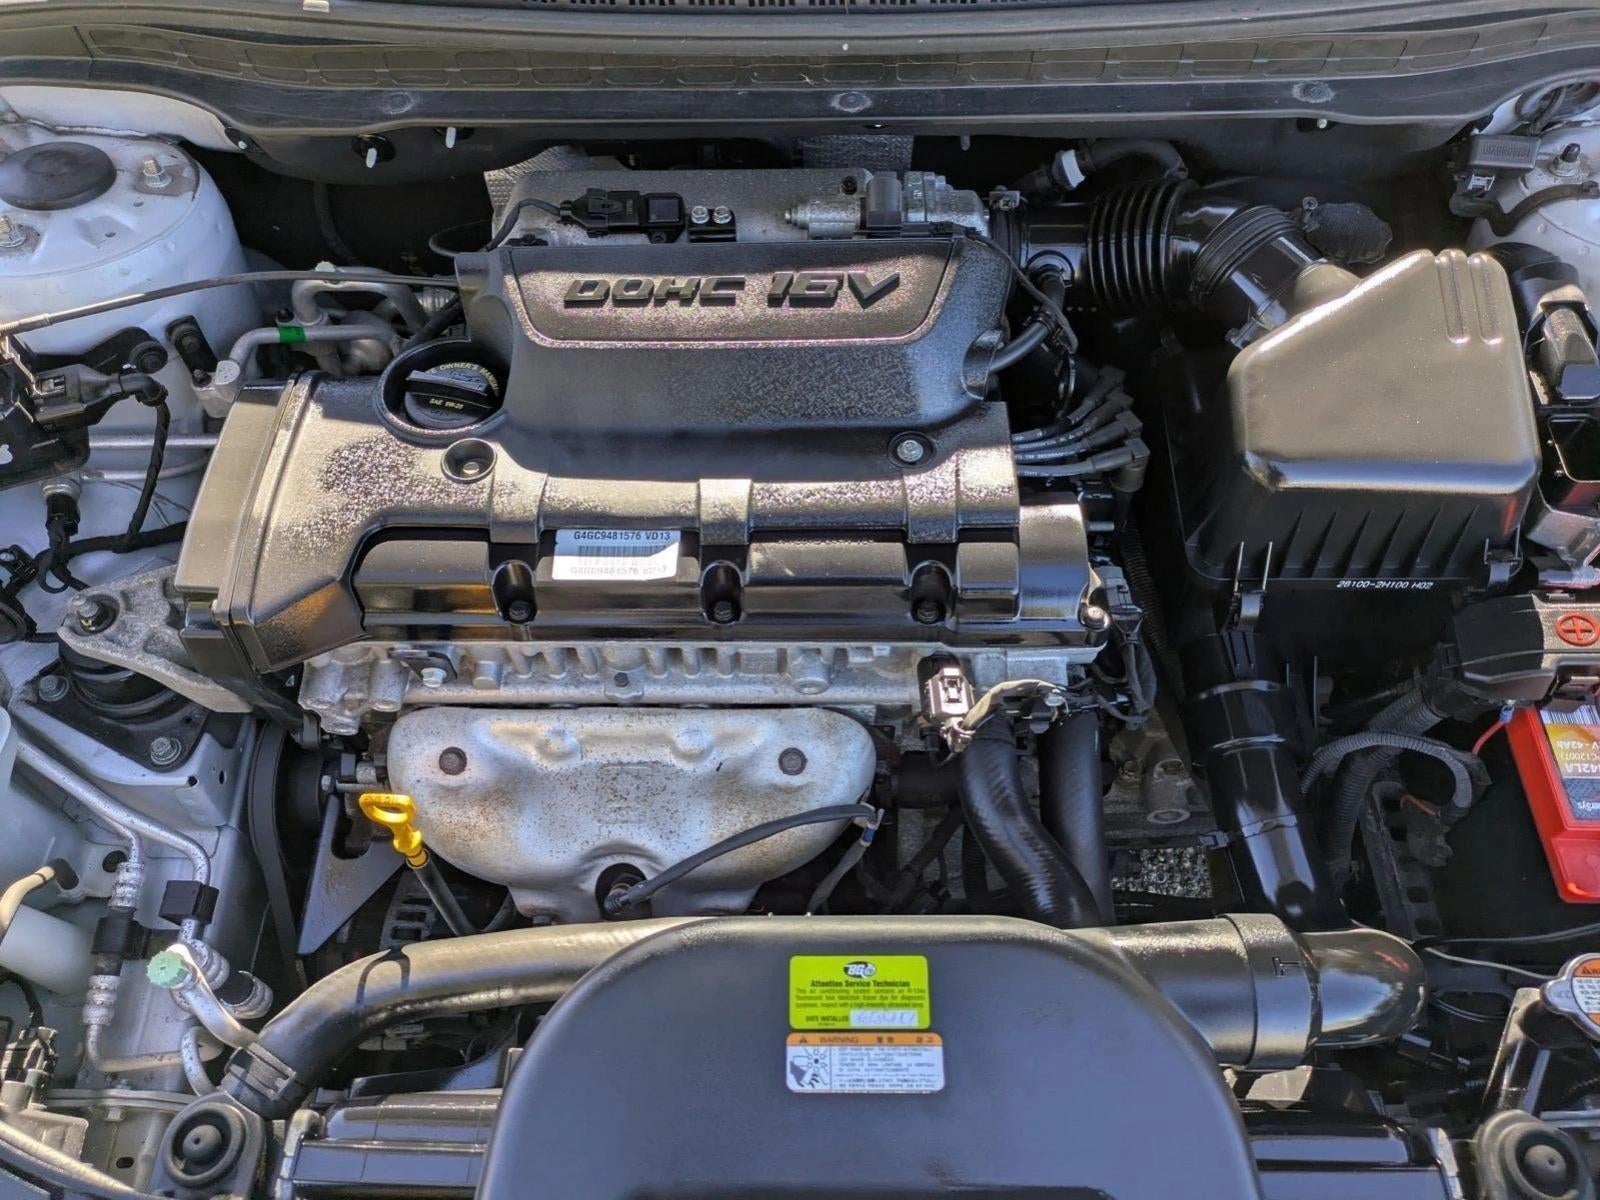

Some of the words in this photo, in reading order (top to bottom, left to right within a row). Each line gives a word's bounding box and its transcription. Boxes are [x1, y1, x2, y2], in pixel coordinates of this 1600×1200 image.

[564, 276, 745, 307] DOHC
[767, 270, 901, 309] 16V
[440, 363, 479, 371] OWNER'S
[574, 531, 641, 540] G4GC9481576
[645, 531, 671, 540] VD13
[1336, 580, 1409, 589] 28100-2H100
[1411, 581, 1434, 590] H02
[811, 979, 843, 987] Attention
[844, 979, 870, 987] Service
[872, 979, 910, 987] Technician
[819, 1035, 859, 1044] WARNING
